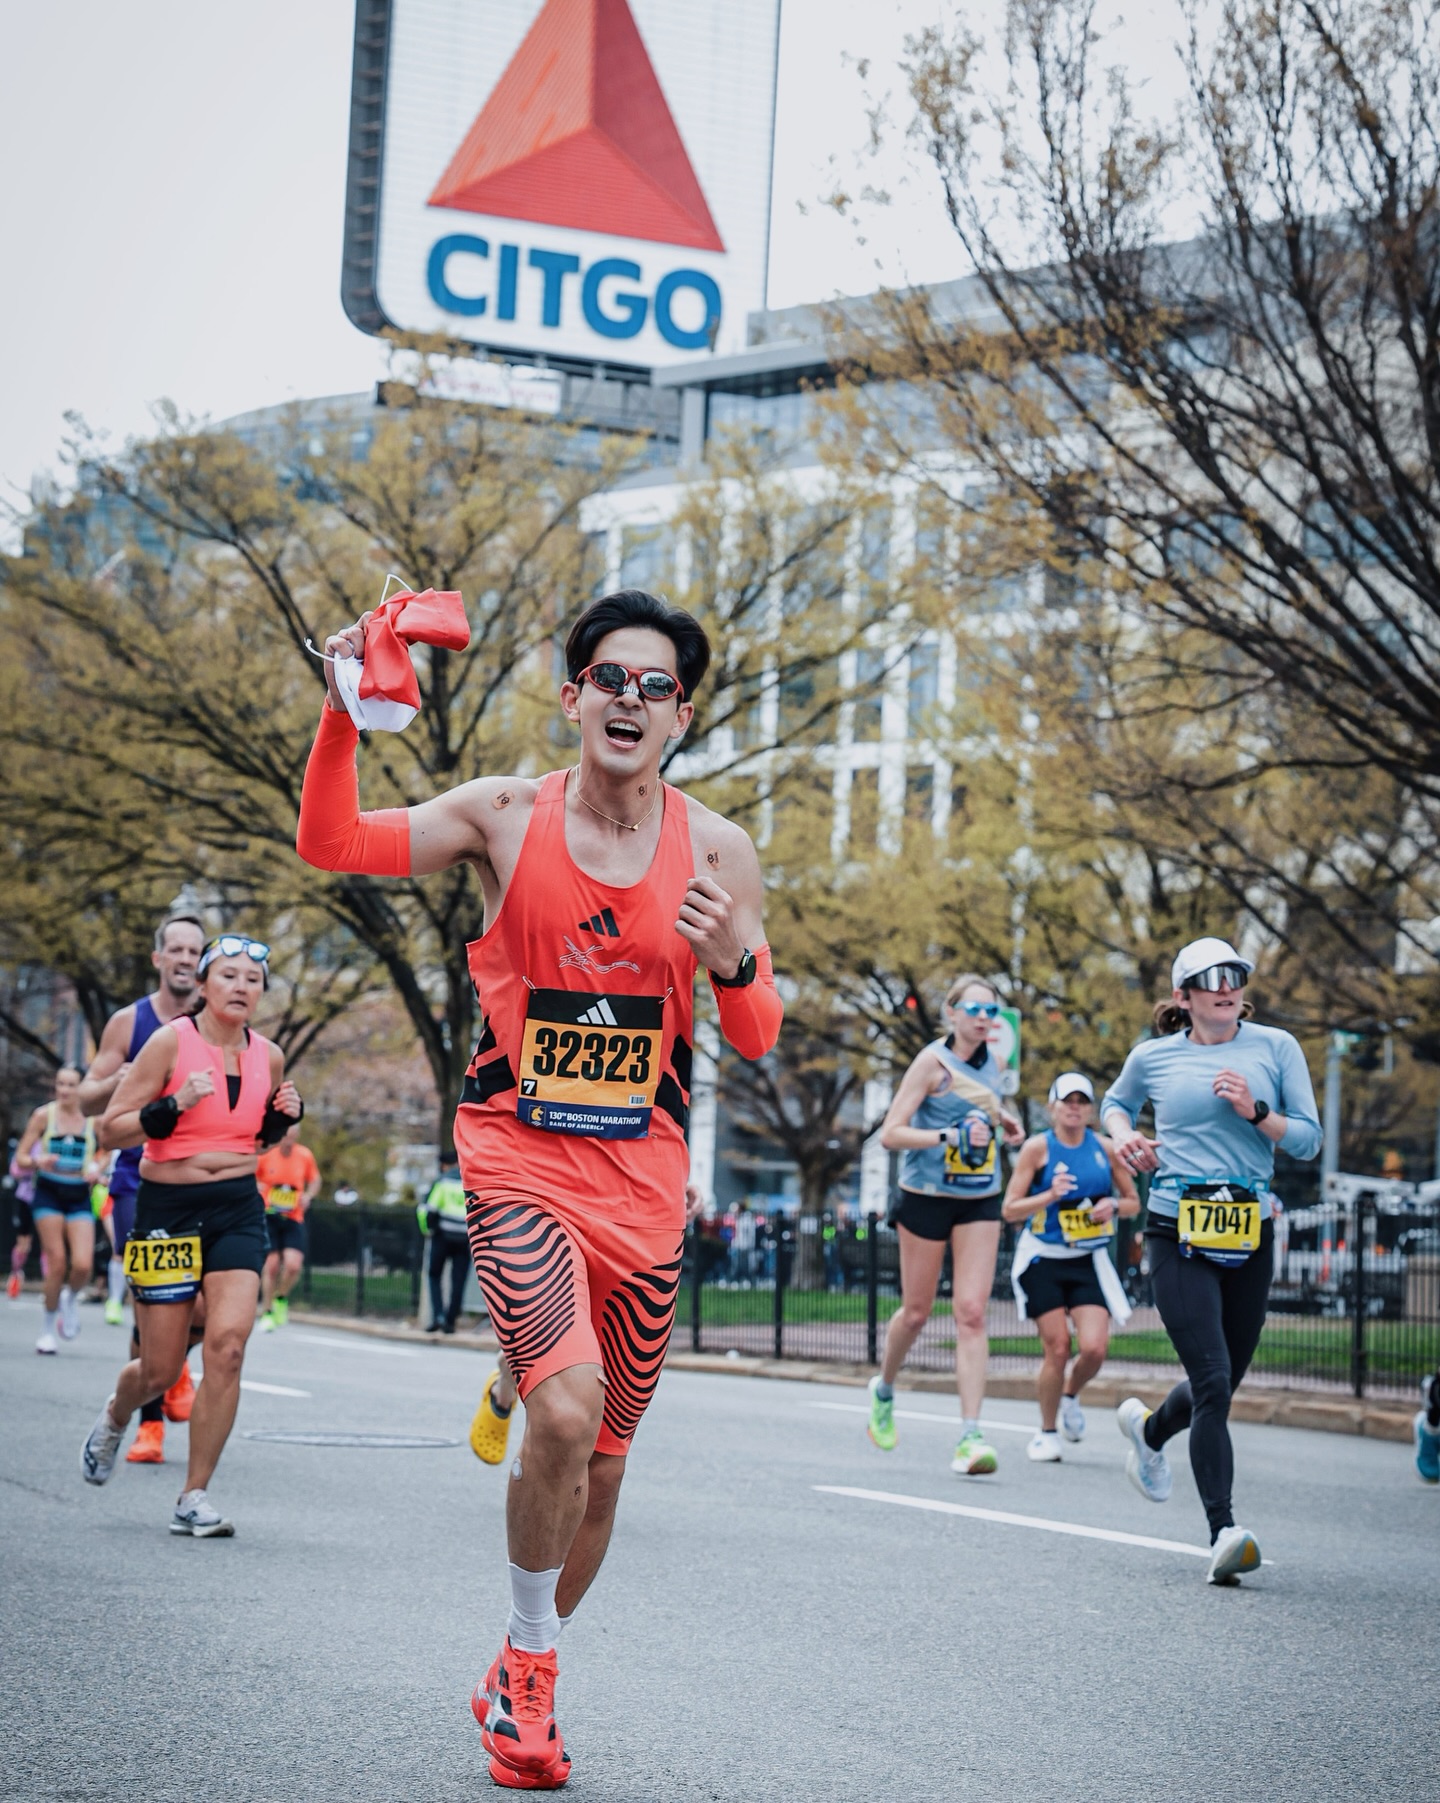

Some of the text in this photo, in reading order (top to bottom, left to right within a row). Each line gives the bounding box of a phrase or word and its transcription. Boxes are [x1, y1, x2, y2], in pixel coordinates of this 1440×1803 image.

[427, 234, 722, 349] CITGO
[532, 1027, 652, 1084] 32323
[523, 1080, 536, 1094] 7
[566, 1113, 599, 1123] BOSTON
[600, 1115, 642, 1125] MARATHON
[576, 1122, 605, 1131] AMERICA
[1187, 1205, 1251, 1235] 17041
[129, 1242, 193, 1272] 21233
